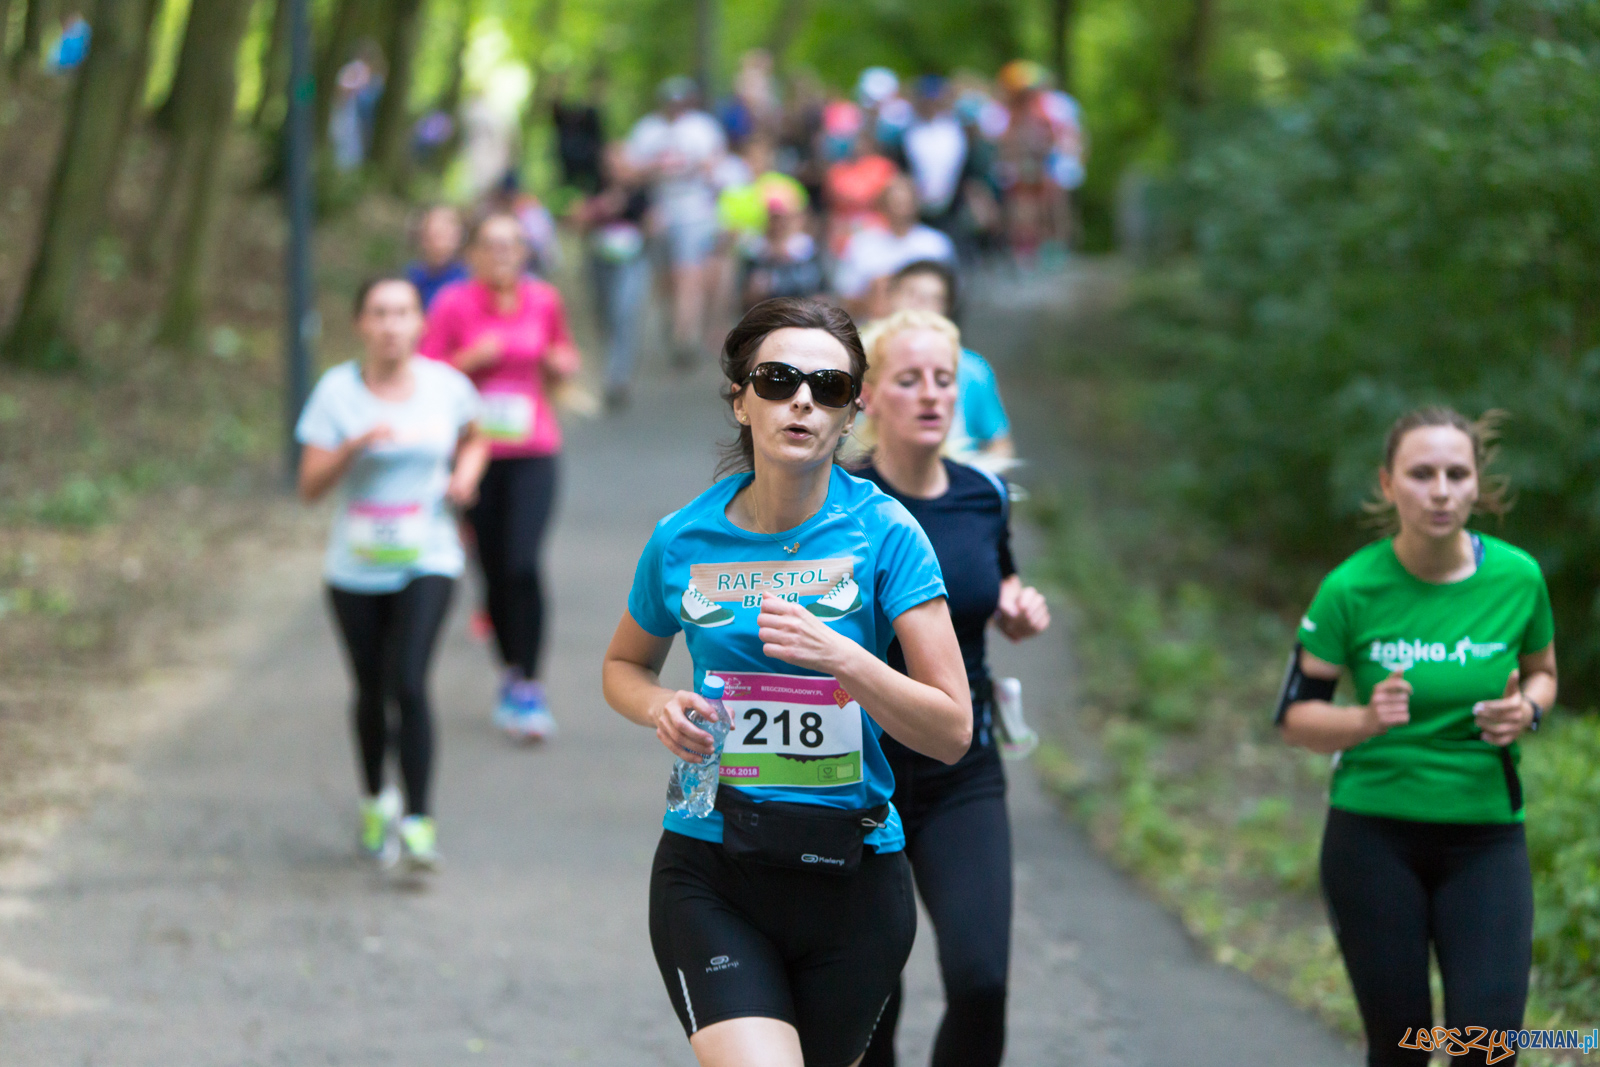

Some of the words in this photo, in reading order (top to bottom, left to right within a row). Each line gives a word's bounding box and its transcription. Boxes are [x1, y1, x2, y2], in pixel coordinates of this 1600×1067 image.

[717, 568, 829, 591] RAF-STOL
[743, 591, 799, 607] Bia
[742, 708, 824, 748] 218
[719, 767, 758, 776] 2.06.2018
